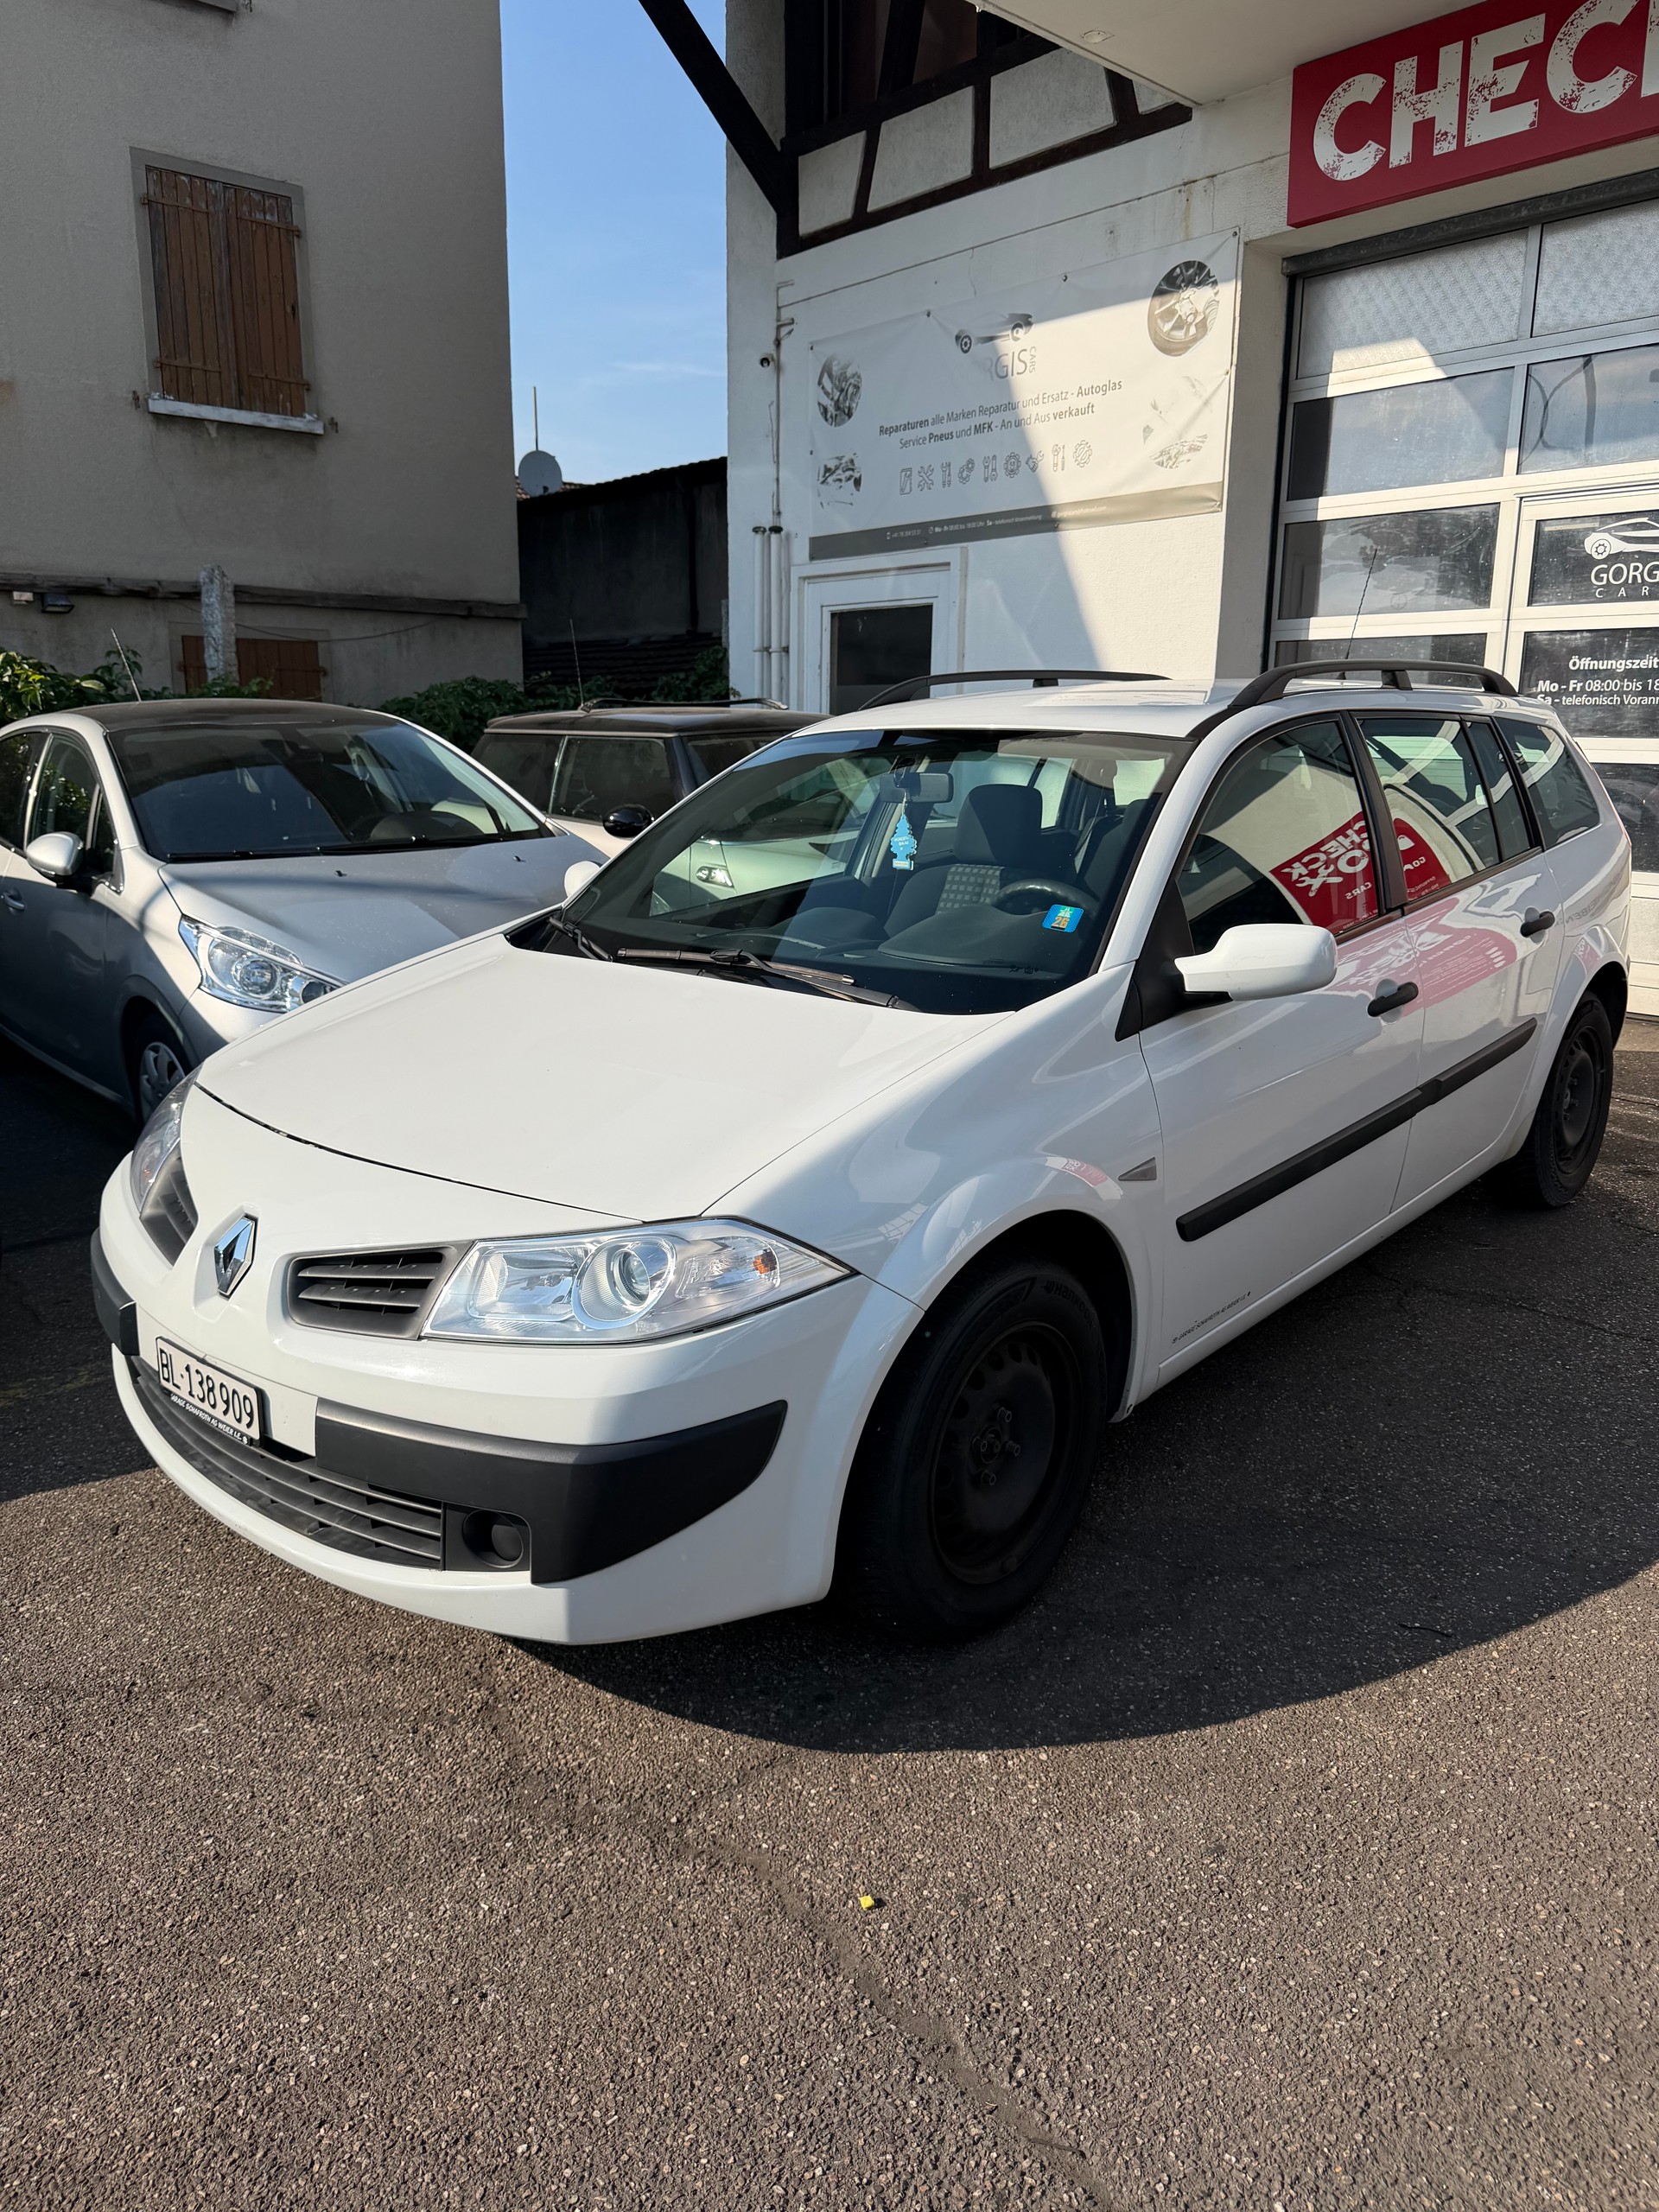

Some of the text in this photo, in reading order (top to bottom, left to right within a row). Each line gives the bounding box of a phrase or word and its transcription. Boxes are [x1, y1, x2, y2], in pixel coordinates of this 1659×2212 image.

[1313, 0, 1659, 181] CHEC
[879, 418, 929, 437] Reparaturen
[931, 413, 944, 427] alle
[946, 409, 976, 423] Marken
[978, 399, 1020, 418] Reparatur
[1021, 394, 1039, 409] und
[1041, 391, 1069, 404] Ersatz
[1077, 379, 1122, 397] Autoglas
[899, 435, 927, 449] Service
[928, 430, 954, 443] Pneus
[956, 424, 971, 439] und
[974, 421, 994, 435] MFK
[1000, 419, 1012, 430] An
[1014, 414, 1032, 429] und
[1033, 412, 1051, 424] Aus
[1052, 402, 1095, 421] verkauft
[1569, 655, 1659, 672] Öffnungszeit
[1537, 680, 1559, 692] Mo
[1568, 679, 1583, 691] Fr
[1585, 679, 1620, 692] 08:00
[1623, 678, 1643, 692] bis
[1537, 694, 1552, 705] Sa
[1561, 694, 1620, 706] telefonisch
[1052, 916, 1070, 929] 26
[170, 1393, 186, 1408] ARAGE
